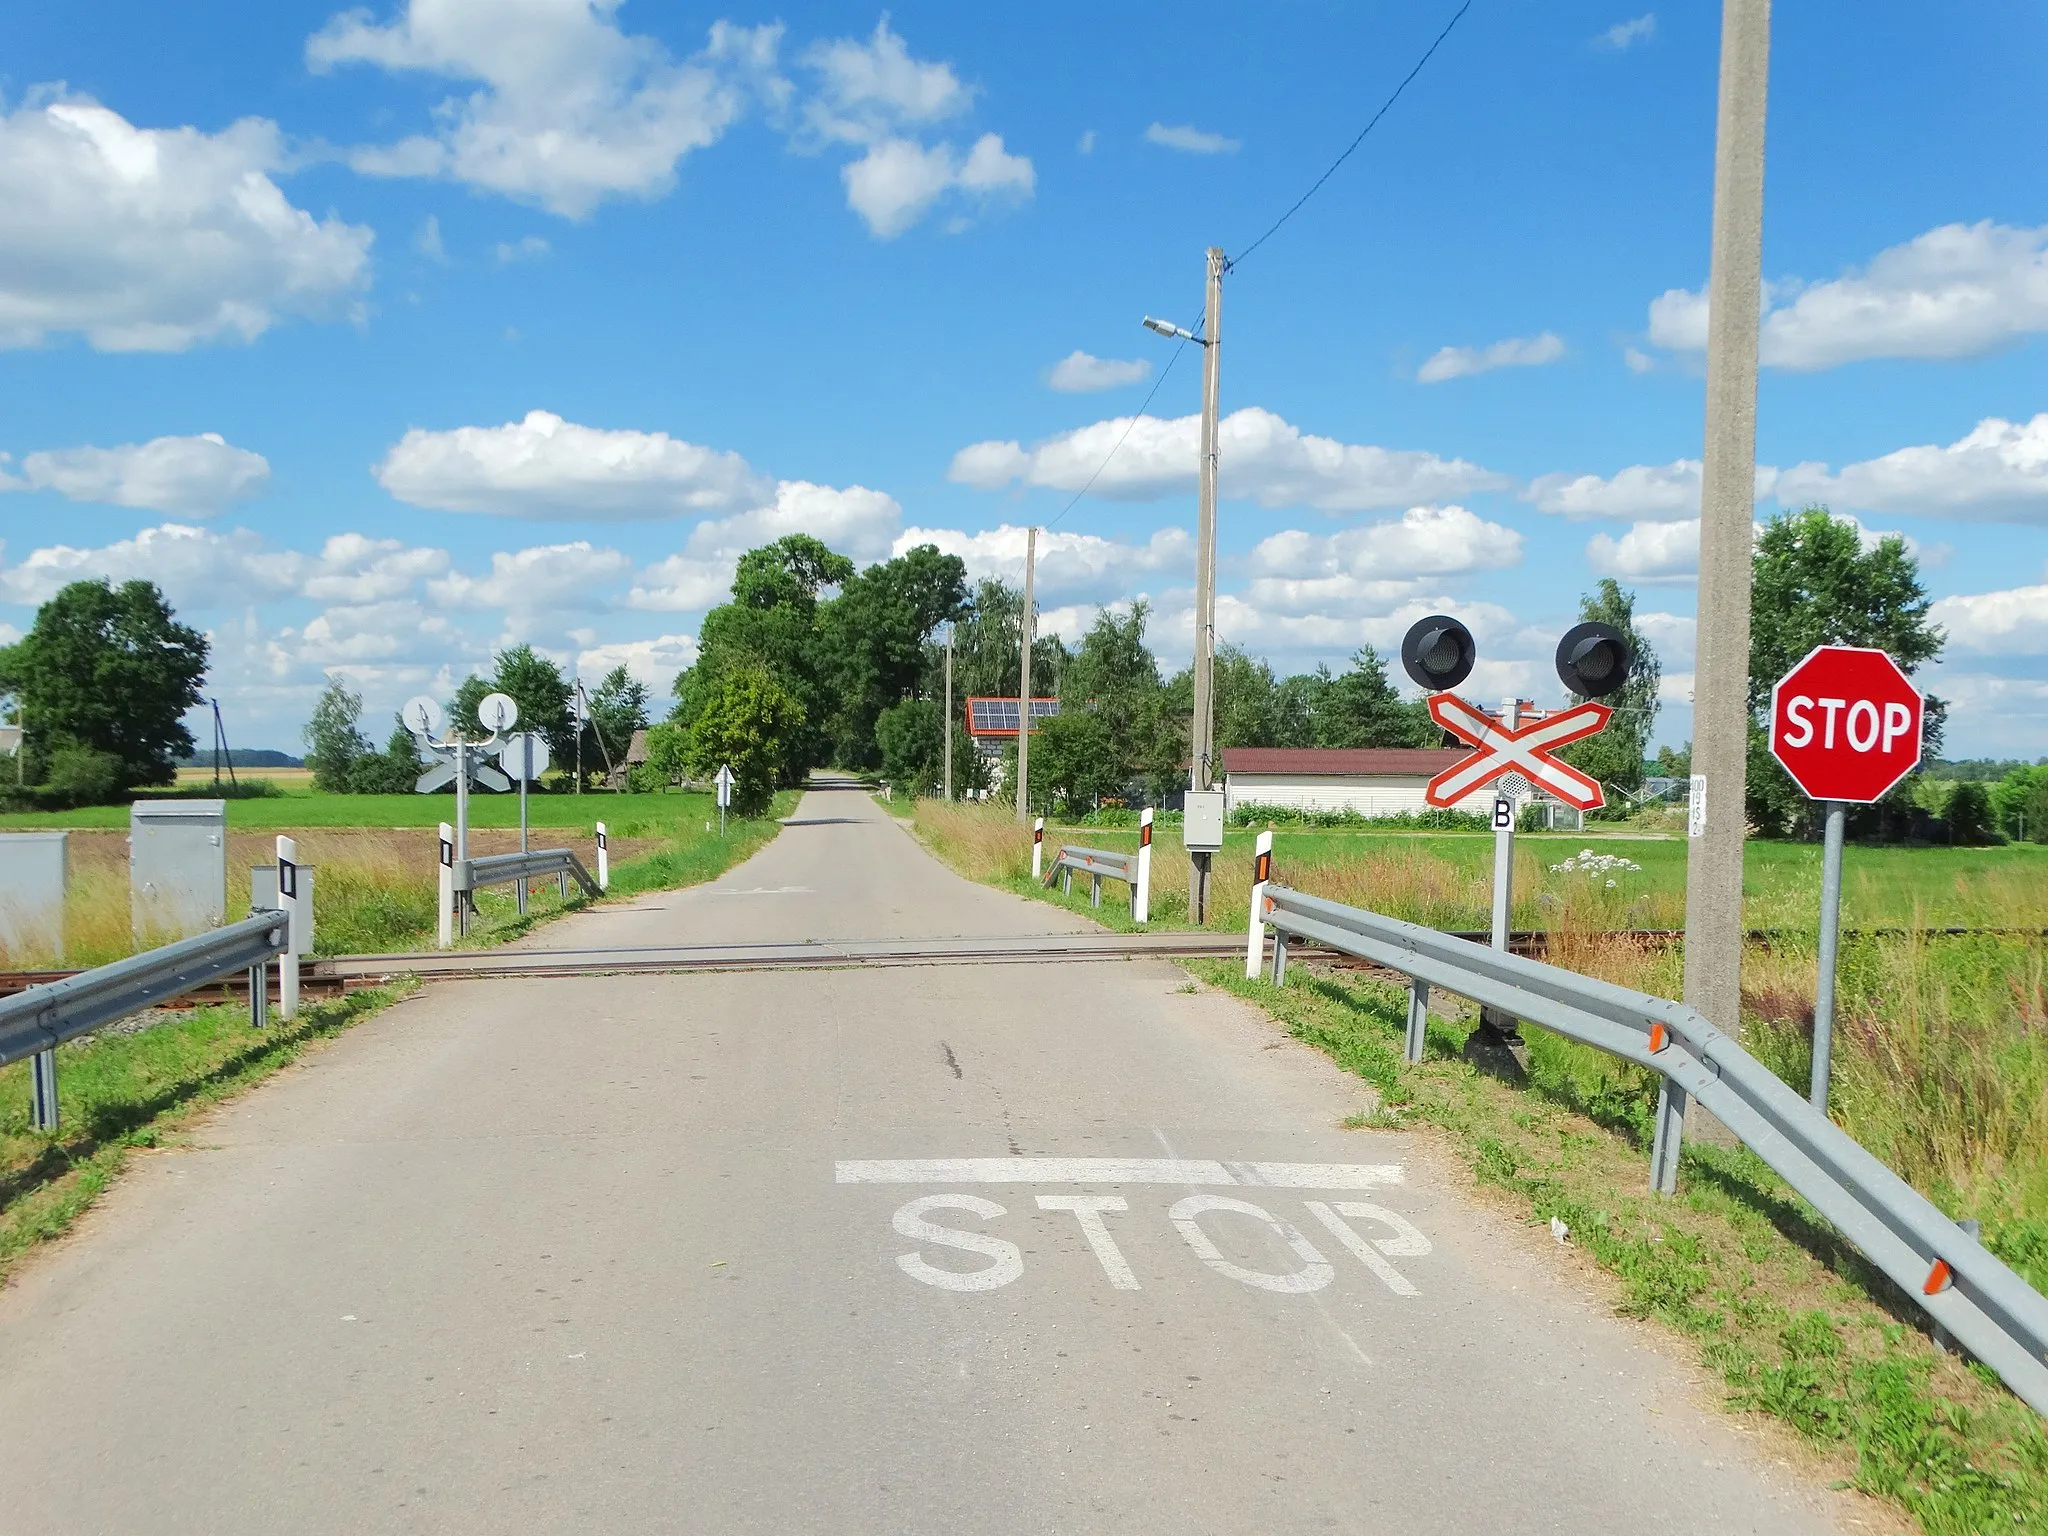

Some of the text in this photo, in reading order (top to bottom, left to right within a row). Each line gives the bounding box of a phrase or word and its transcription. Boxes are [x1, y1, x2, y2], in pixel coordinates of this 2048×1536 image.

[1783, 695, 1911, 753] STOP
[1495, 800, 1510, 827] B
[892, 1193, 1433, 1296] STOP
